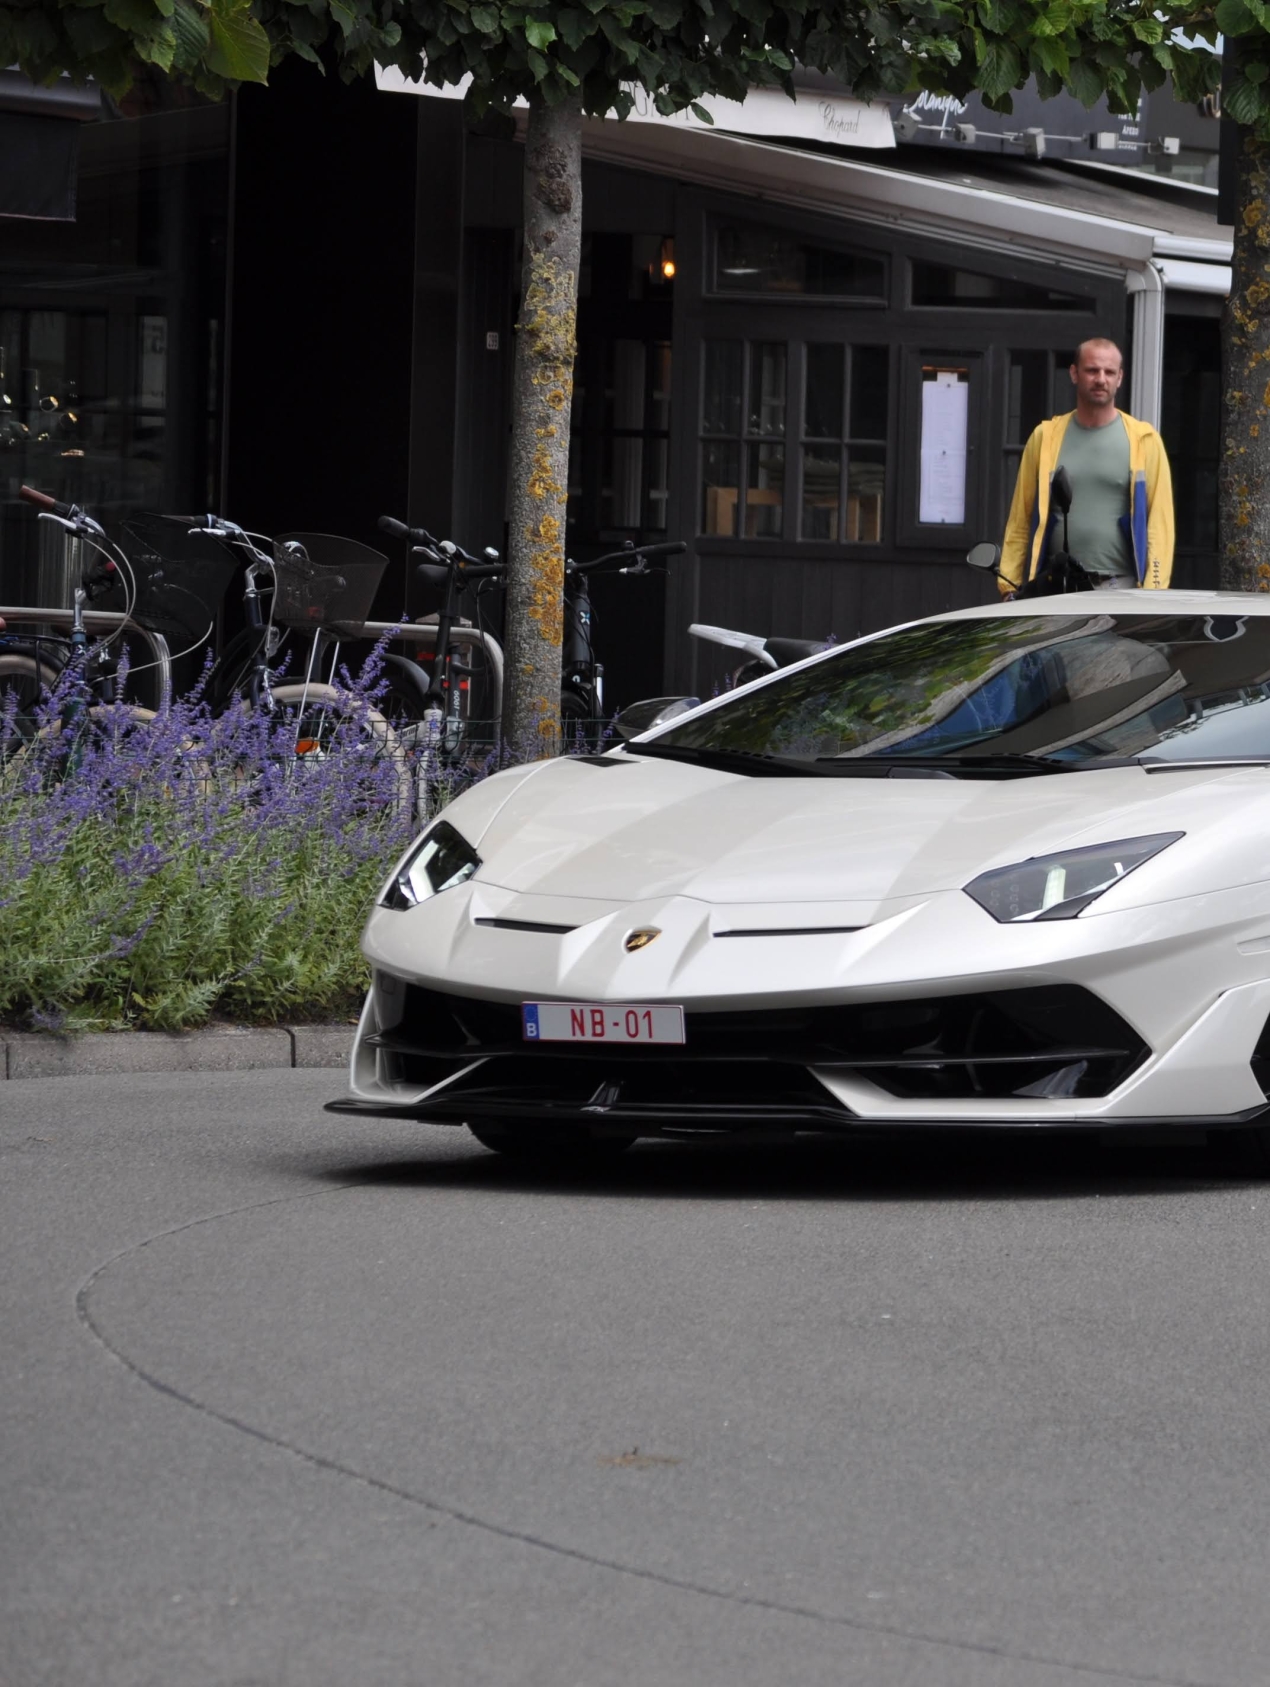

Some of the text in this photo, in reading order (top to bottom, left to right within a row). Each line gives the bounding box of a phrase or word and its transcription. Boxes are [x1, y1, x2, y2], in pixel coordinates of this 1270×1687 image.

[817, 100, 861, 138] Chopard
[526, 1022, 538, 1037] B
[570, 1008, 654, 1039] NB-01
